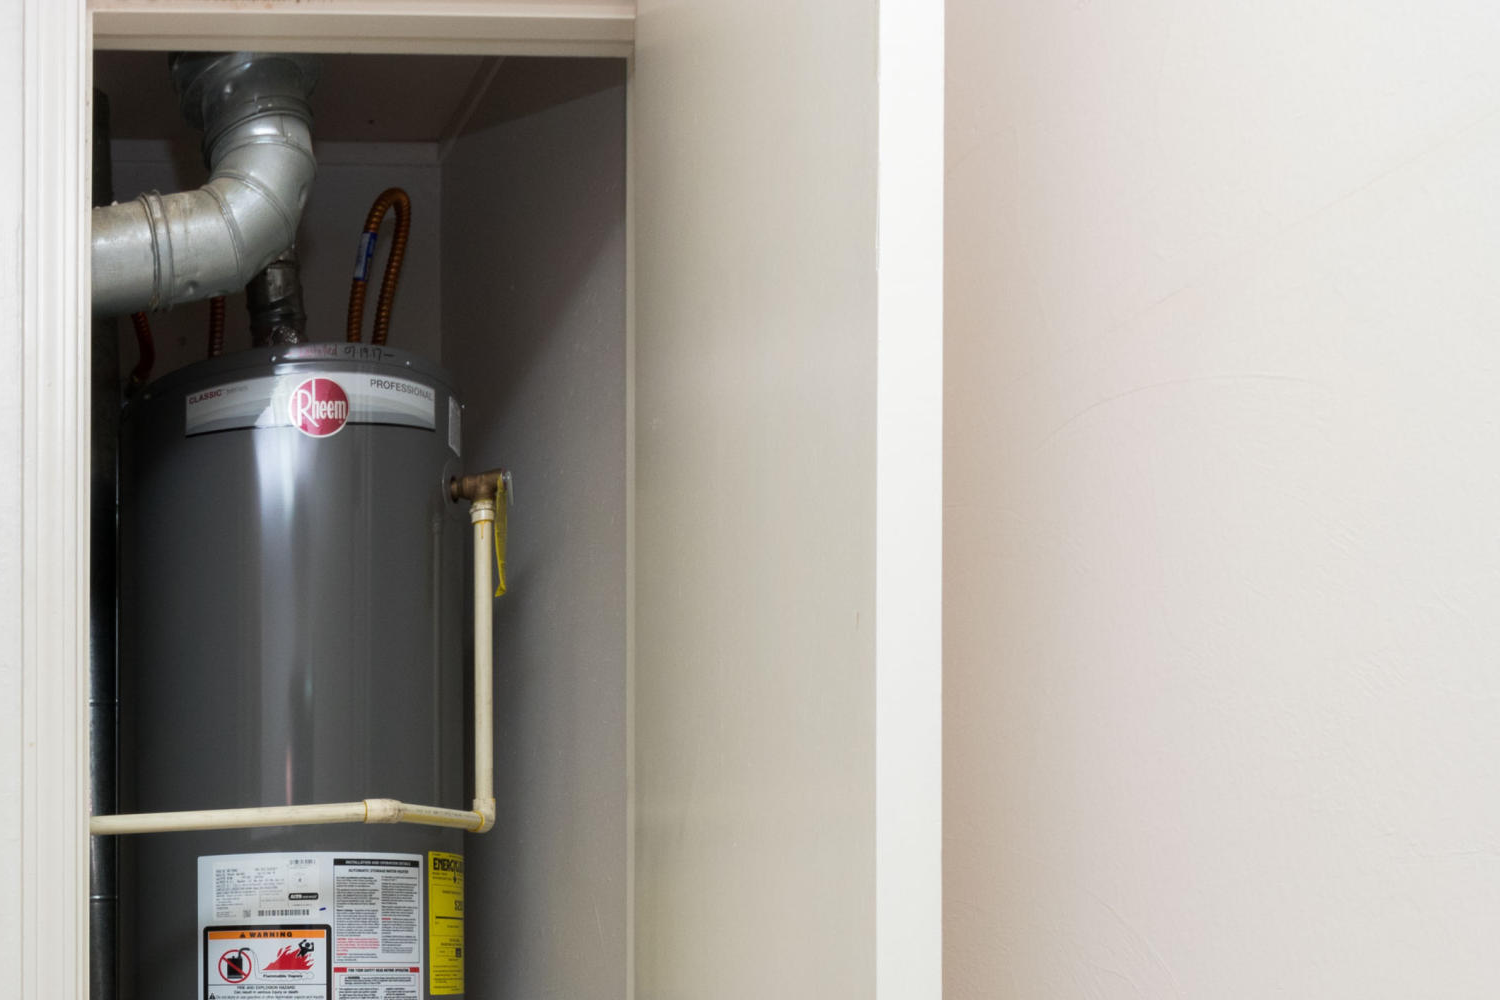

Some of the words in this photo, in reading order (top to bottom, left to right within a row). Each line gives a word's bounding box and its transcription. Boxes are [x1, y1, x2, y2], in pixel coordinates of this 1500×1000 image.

[188, 389, 222, 405] CLASSIC
[369, 378, 433, 400] PROFESSIONAL
[296, 378, 346, 428] Rheem
